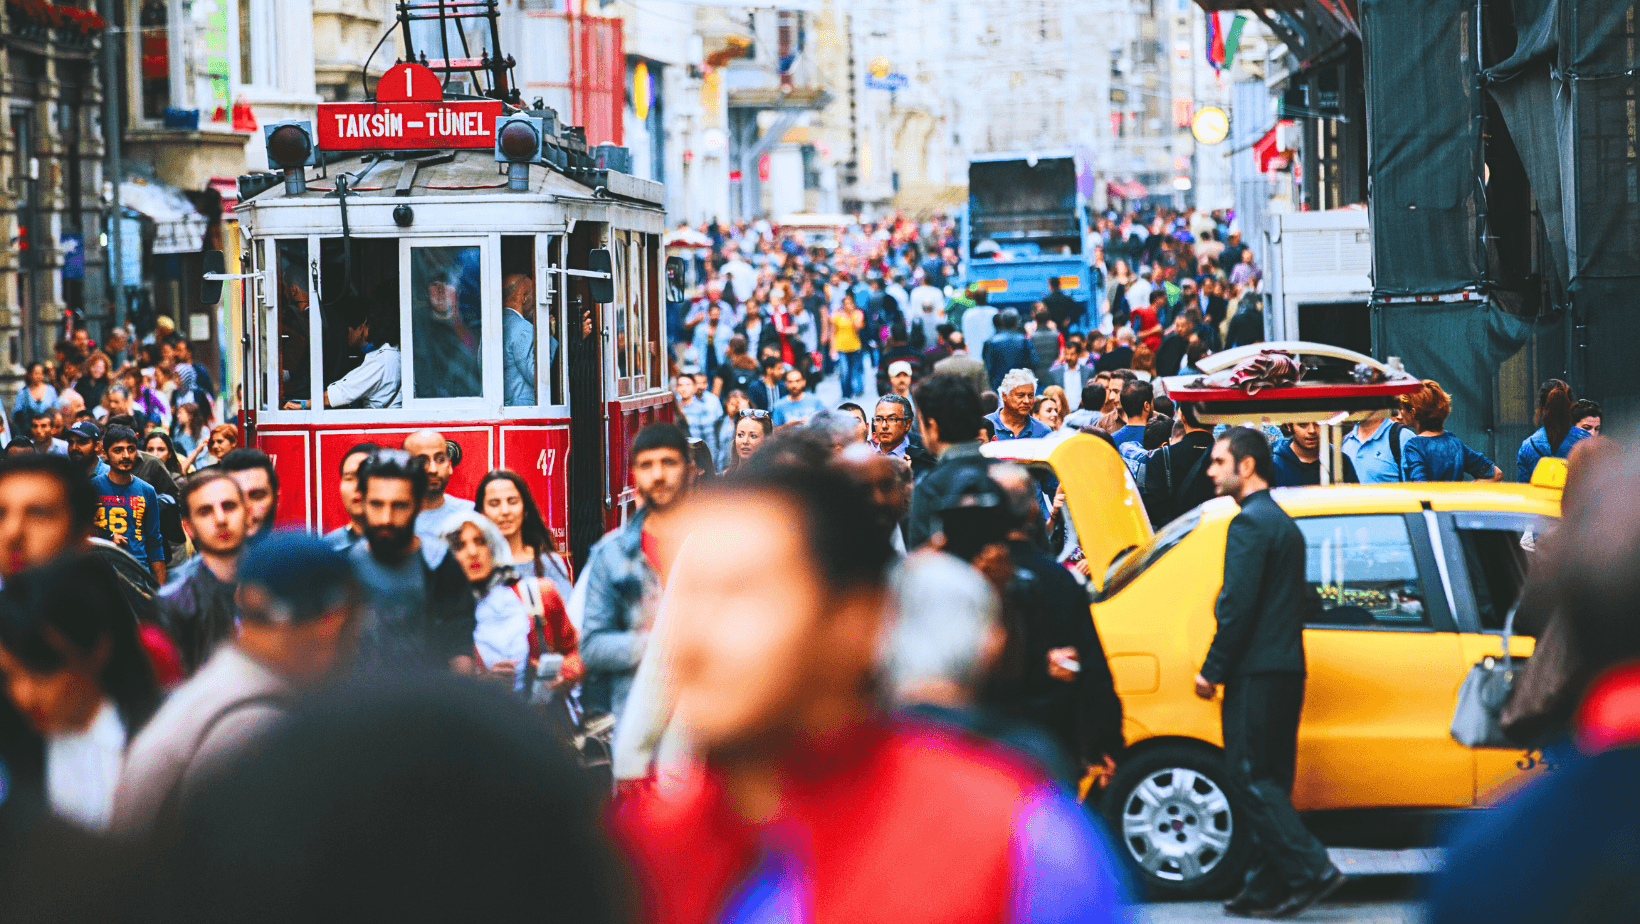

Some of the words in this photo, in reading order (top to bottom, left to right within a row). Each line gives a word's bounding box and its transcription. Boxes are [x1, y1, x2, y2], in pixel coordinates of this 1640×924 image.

[404, 67, 413, 98] 1
[334, 108, 403, 138] TAKSİM
[425, 107, 491, 136] TÜNEL
[537, 448, 556, 476] 47
[93, 506, 128, 534] 46
